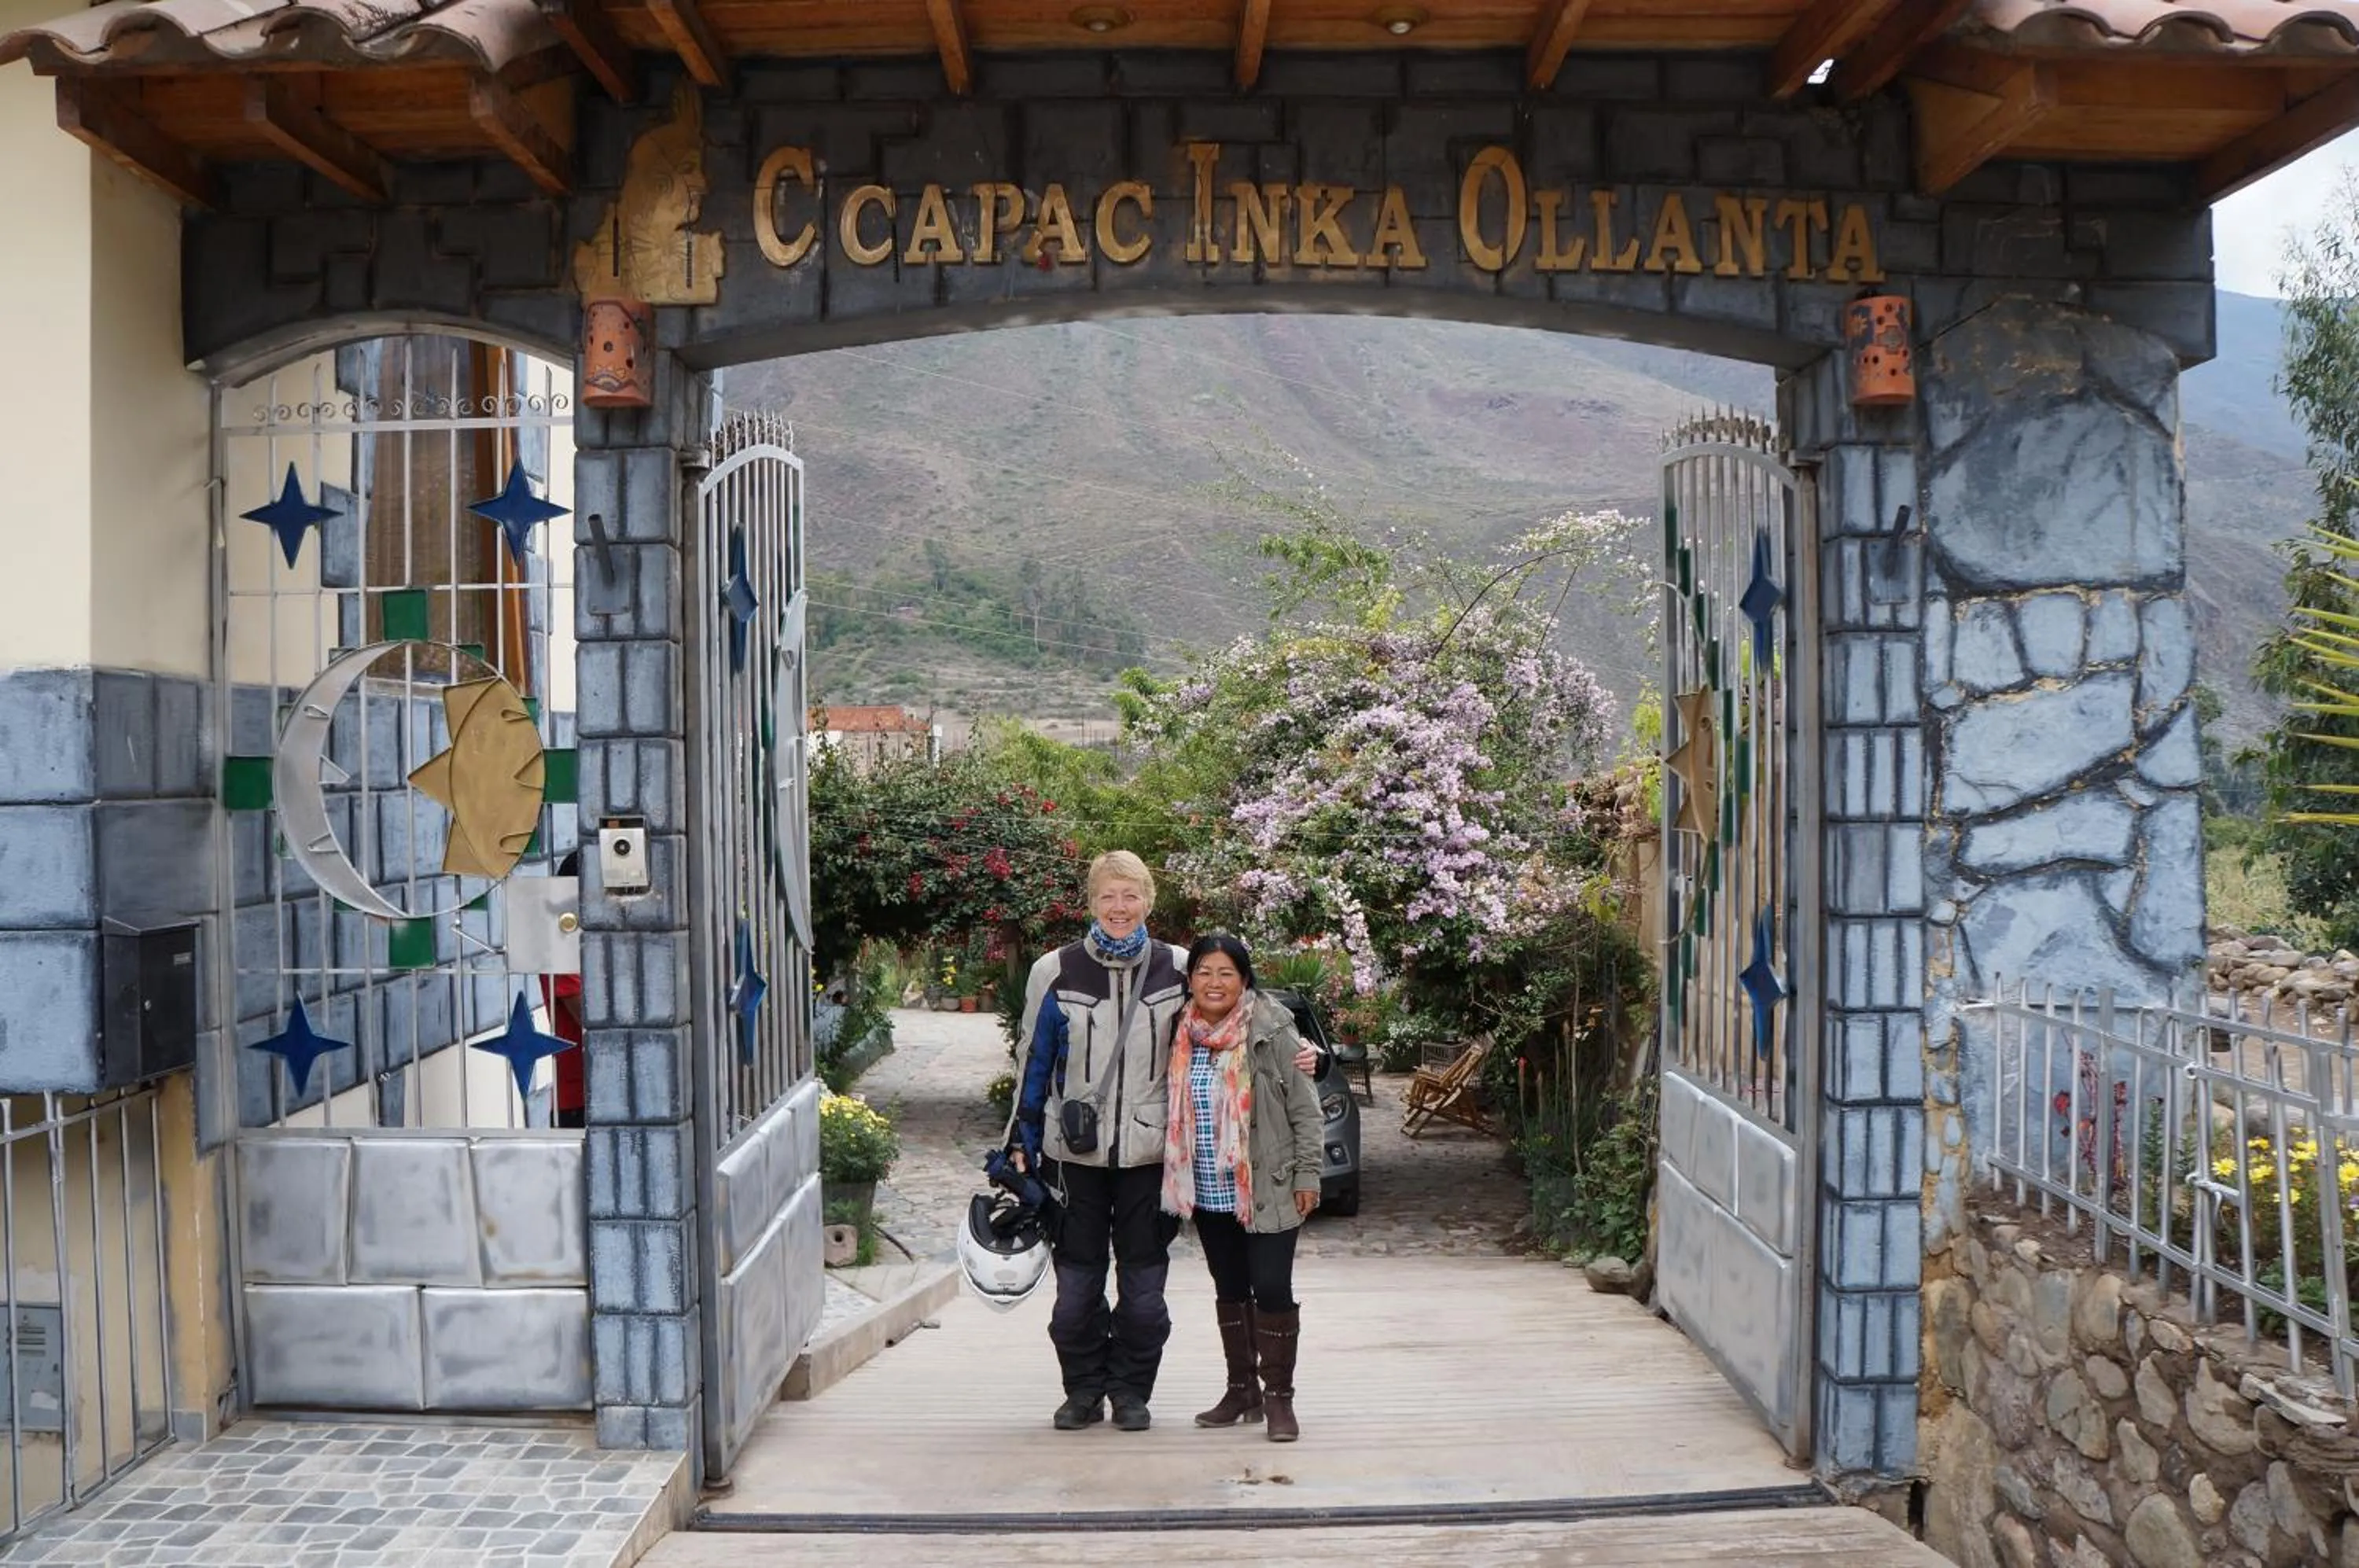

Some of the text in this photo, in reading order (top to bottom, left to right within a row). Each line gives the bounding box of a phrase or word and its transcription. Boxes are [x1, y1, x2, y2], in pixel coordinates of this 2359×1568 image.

[752, 142, 1886, 283] CCAPAC INKA OLLANTA
